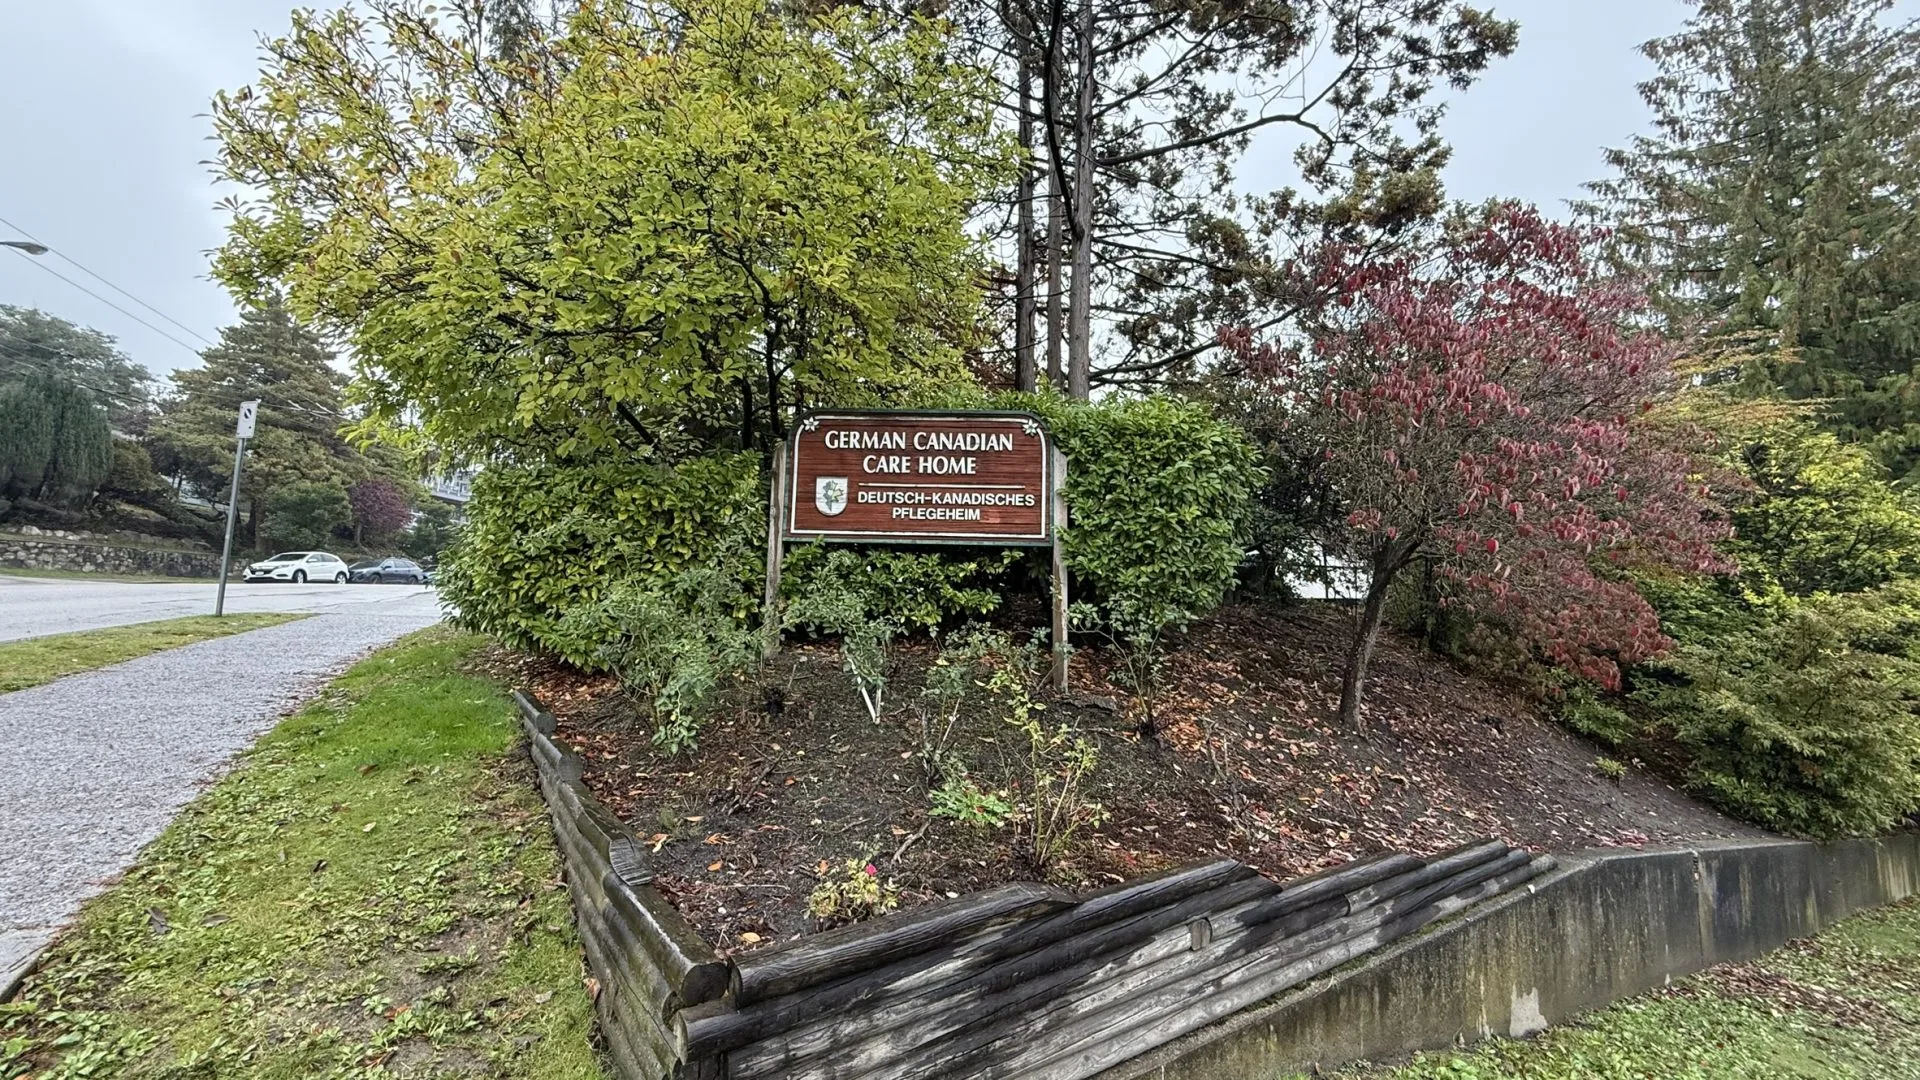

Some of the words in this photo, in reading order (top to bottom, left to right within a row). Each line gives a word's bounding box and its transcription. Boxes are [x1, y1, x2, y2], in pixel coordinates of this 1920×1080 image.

[825, 430, 906, 450] GERMAN
[913, 431, 1013, 451] CANADIAN
[863, 455, 911, 474] CARE
[918, 456, 977, 475] HOME
[857, 491, 1035, 507] DEUTSCH-KANADISCHES
[892, 508, 980, 521] PFLEGEHEIM
